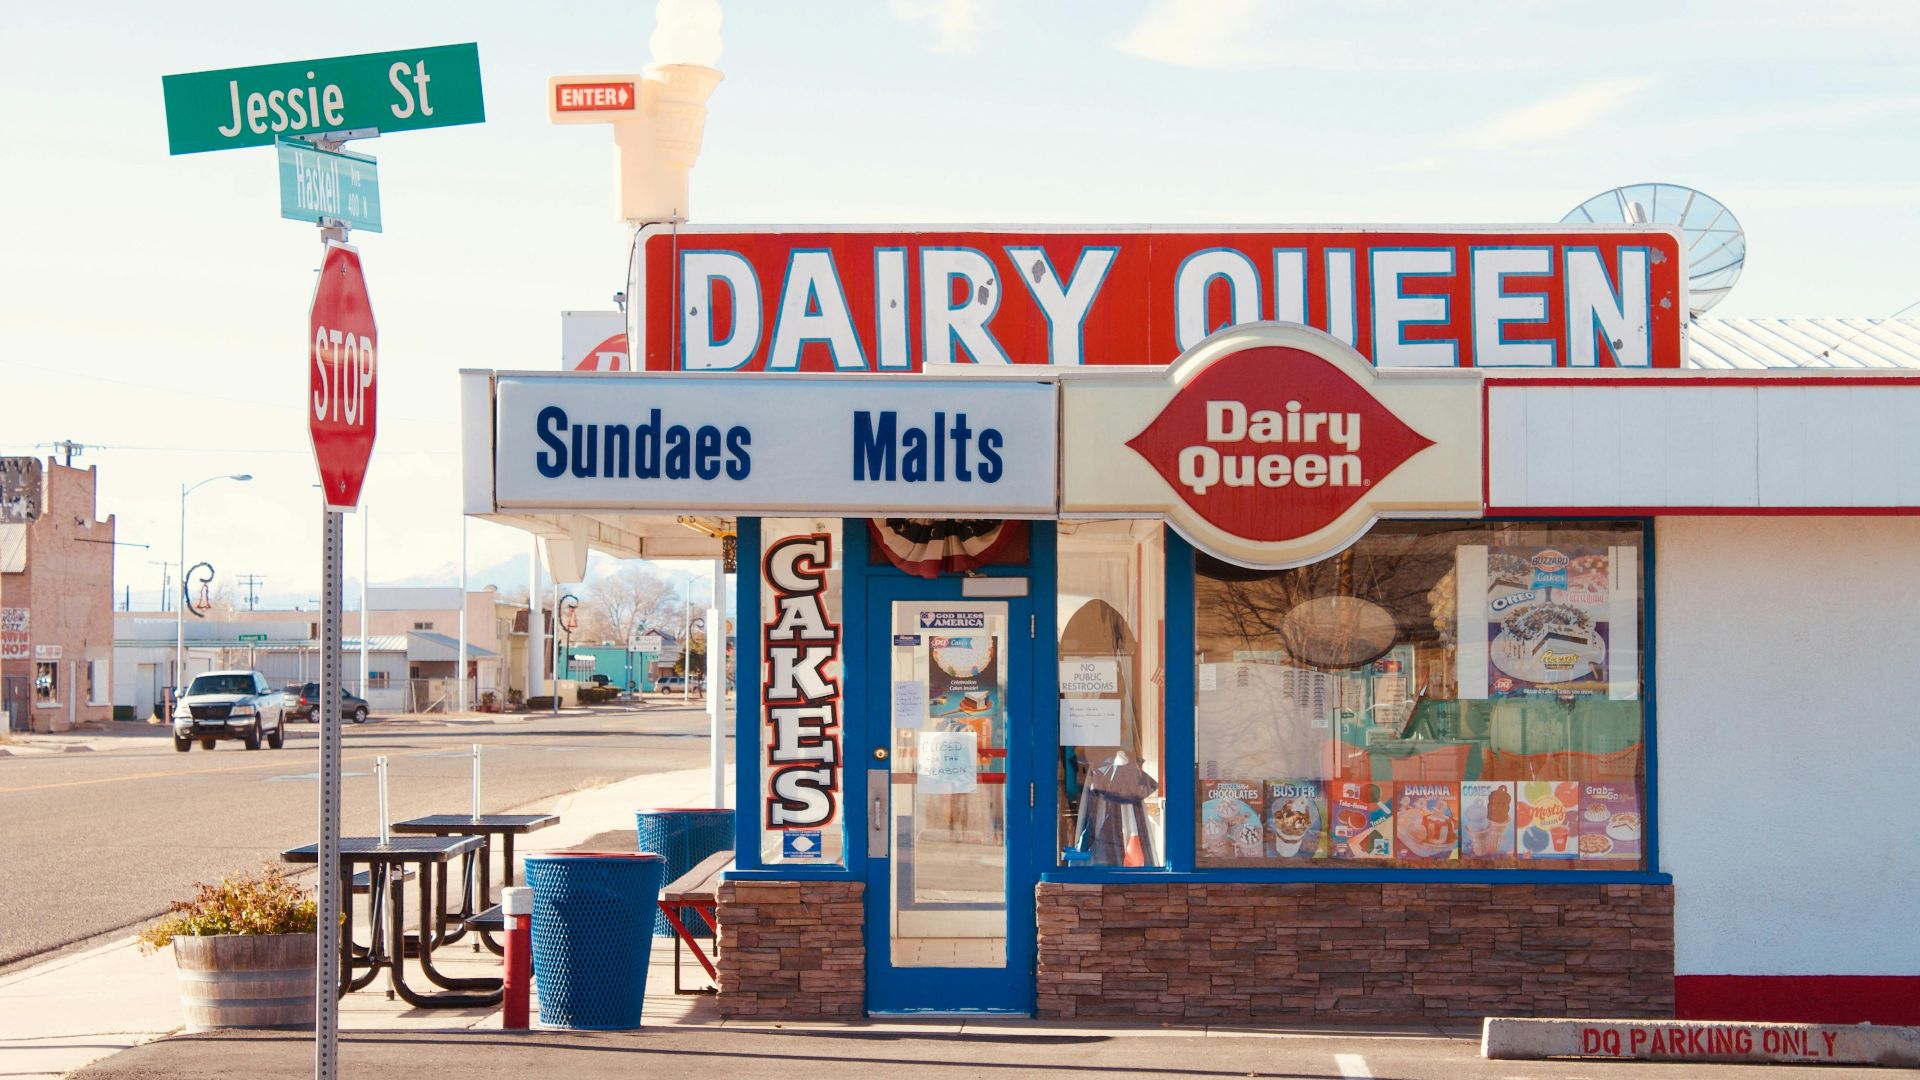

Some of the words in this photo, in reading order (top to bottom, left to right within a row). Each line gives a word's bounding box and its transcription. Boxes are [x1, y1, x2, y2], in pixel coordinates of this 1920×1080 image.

[218, 71, 345, 138] Jessie
[388, 59, 434, 119] St
[561, 87, 617, 107] ENTER
[295, 151, 341, 215] Haskell
[680, 245, 1121, 371] DAIRY
[1174, 245, 1653, 369] QUEEN
[314, 325, 374, 426] STOP
[1205, 400, 1361, 450] Dairy
[536, 405, 752, 481] Sundaes
[852, 410, 1004, 483] Malts
[1178, 445, 1363, 495] Queen
[1537, 572, 1565, 582] Cakes
[1491, 592, 1535, 611] OREO
[934, 619, 984, 627] AMERICA
[1080, 663, 1096, 672] NO
[763, 533, 841, 830] CAKES
[1074, 673, 1102, 681] PUBLIC
[1062, 682, 1114, 690] RESTROOMS
[923, 766, 967, 777] SEASON
[1208, 789, 1259, 800] CHOCOLATES
[1273, 785, 1316, 798] BUSTER
[1404, 784, 1450, 796] BANANA
[1463, 785, 1491, 797] CONES
[1586, 786, 1607, 795] Grab
[1607, 791, 1619, 800] Go
[1583, 1028, 1621, 1056] DQ
[1630, 1027, 1753, 1056] PARKING
[1763, 1028, 1838, 1058] ONLY
